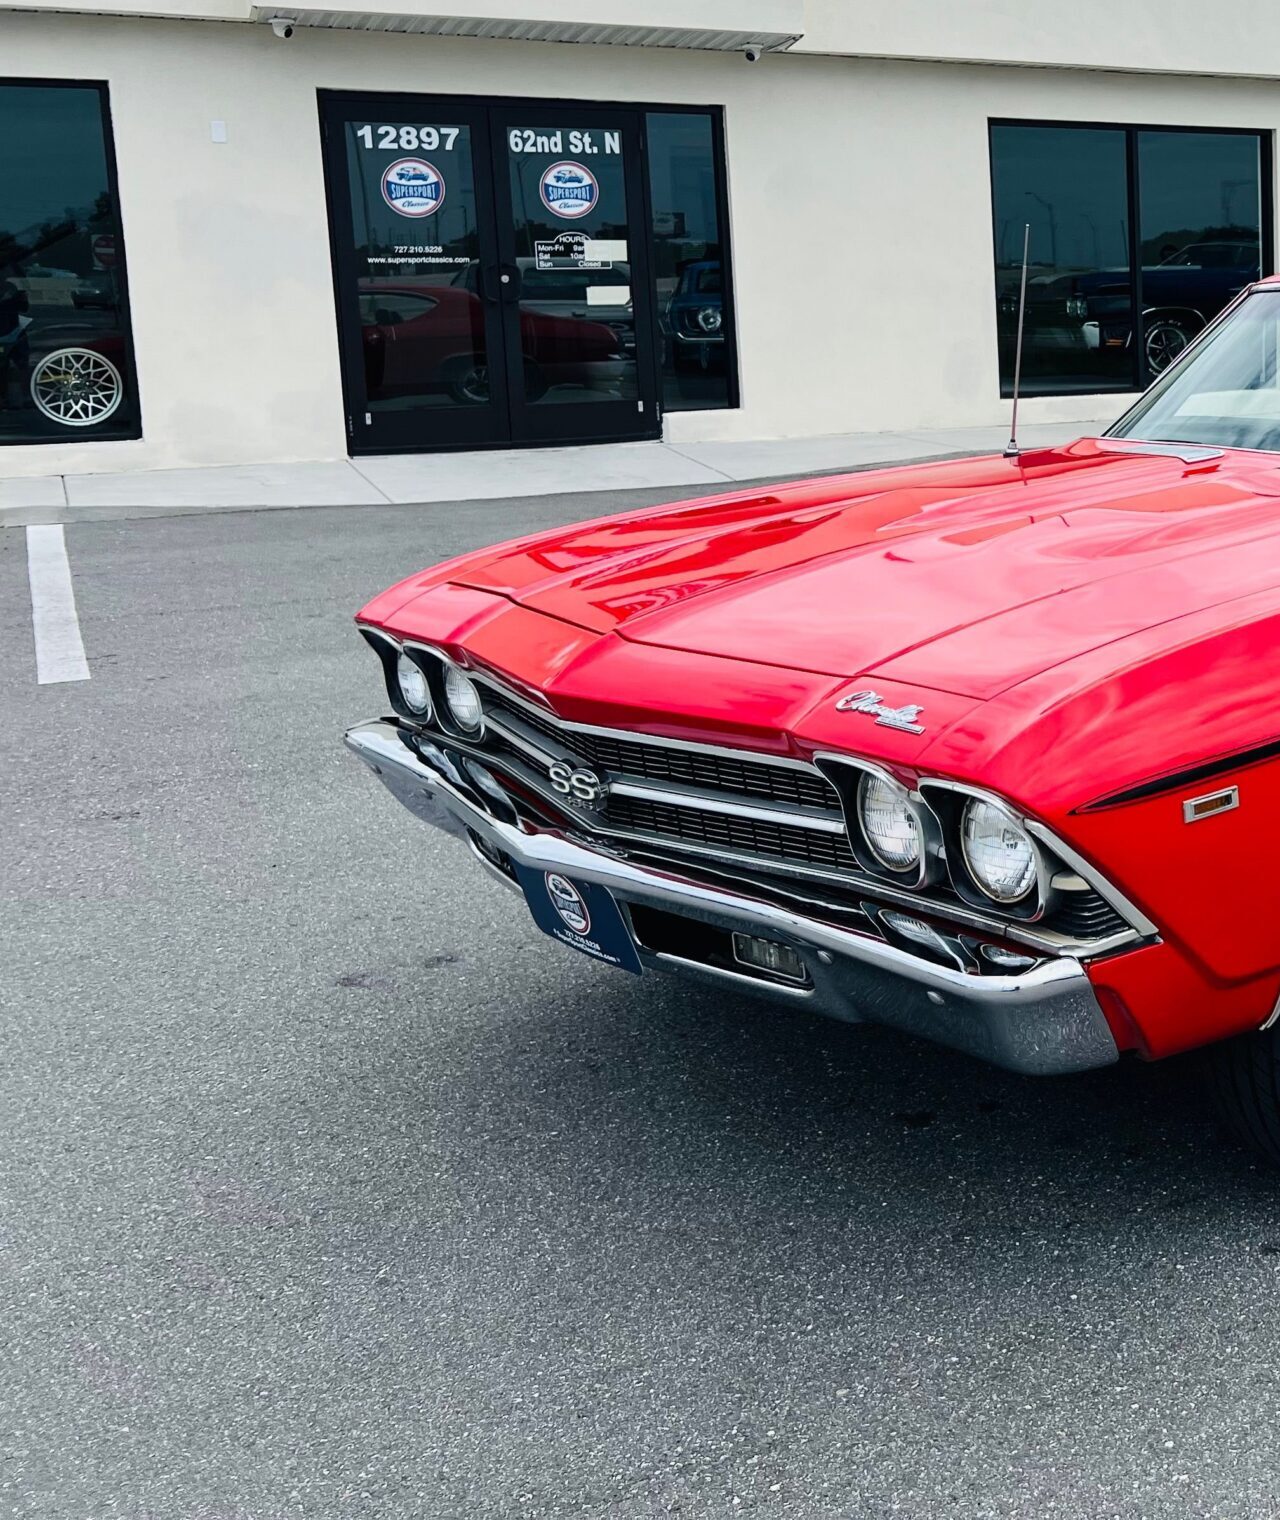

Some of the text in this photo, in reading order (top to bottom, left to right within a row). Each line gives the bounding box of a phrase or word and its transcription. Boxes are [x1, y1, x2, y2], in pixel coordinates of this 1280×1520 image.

[357, 125, 460, 151] 12897
[509, 129, 620, 154] 62nd St. N
[391, 183, 436, 199] SUPERSPORT
[548, 186, 590, 201] SUPERSPORT
[367, 256, 470, 265] www.supersportclassics.com
[578, 260, 602, 268] Closed
[549, 762, 599, 800] SS
